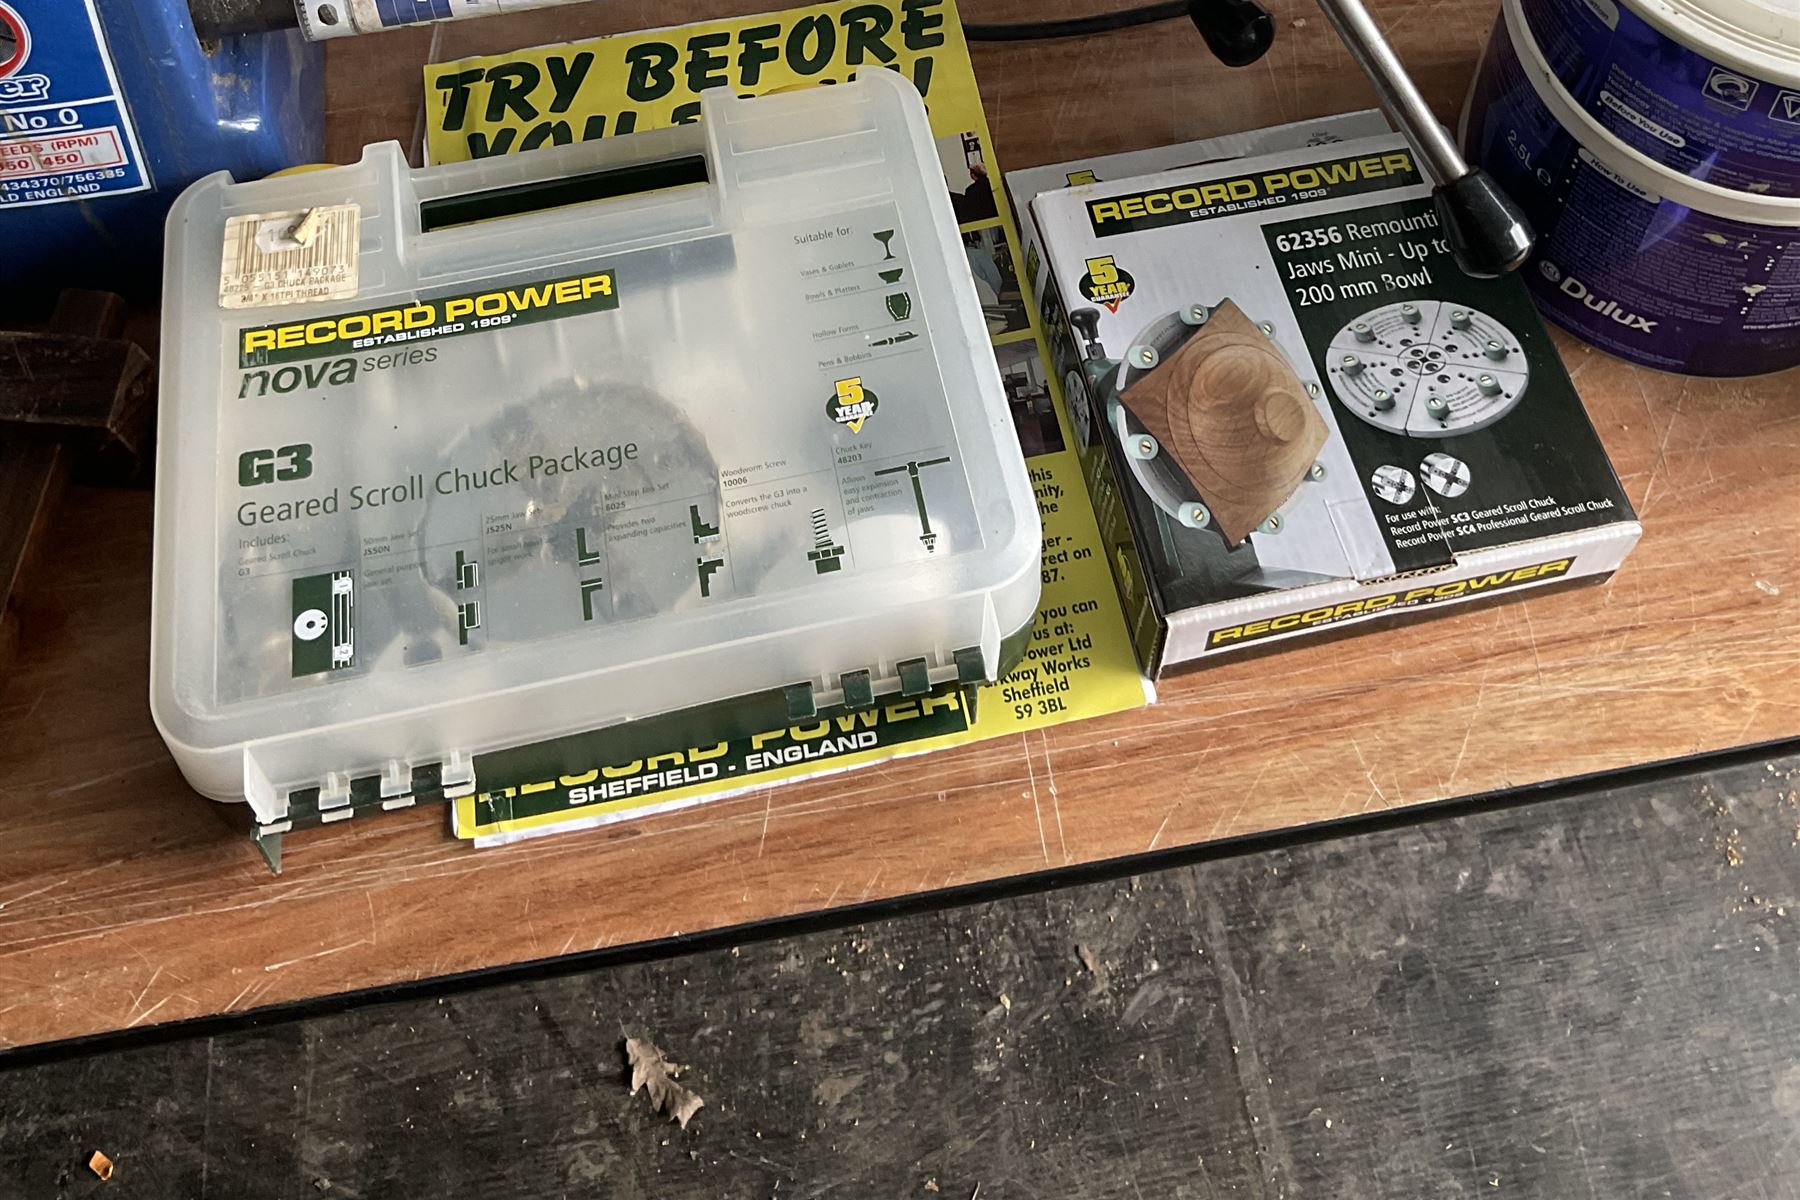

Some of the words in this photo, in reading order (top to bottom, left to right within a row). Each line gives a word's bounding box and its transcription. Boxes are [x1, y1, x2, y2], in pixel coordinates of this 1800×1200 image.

[434, 51, 594, 132] TRY
[4, 113, 48, 131] No
[1605, 95, 1637, 121] Before
[1639, 117, 1658, 134] You
[1659, 130, 1681, 145] Use
[0, 143, 44, 157] EEDS
[51, 136, 99, 151] (RPM)
[1507, 129, 1533, 171] 2.5L
[42, 153, 79, 166] 450
[1590, 158, 1611, 176] How
[1613, 173, 1625, 185] To
[1626, 181, 1647, 197] Use
[25, 182, 101, 200] ENGLAND
[1092, 179, 1258, 224] RECORD
[1263, 153, 1413, 196] POWER
[1190, 194, 1286, 219] ESTABLISHED
[793, 229, 834, 245] Suitable
[1275, 225, 1343, 253] 62356
[1345, 209, 1440, 242] Remounti
[1287, 257, 1335, 280] Jaws
[1337, 247, 1384, 271] Mini
[1399, 241, 1429, 263] Up
[1431, 236, 1450, 256] to
[800, 268, 820, 277] Vases
[829, 261, 855, 271] Goblets
[1085, 255, 1119, 285] 5
[277, 278, 306, 289] CHUCK
[308, 274, 347, 286] PACKAGE
[1295, 282, 1336, 307] 200
[1340, 279, 1378, 299] mm
[1381, 266, 1433, 293] Bowl
[296, 286, 330, 297] THREAD
[804, 291, 826, 300] Bowls
[835, 284, 861, 295] Platters
[243, 303, 436, 353] RECORD
[445, 273, 612, 323] POWER
[1559, 276, 1659, 334] Dulux
[352, 322, 466, 349] ESTABLISHED
[812, 329, 837, 339] Hollow
[838, 324, 860, 334] Forms
[818, 359, 835, 368] Pens
[844, 351, 872, 363] Bobbins
[237, 357, 358, 399] nova
[362, 344, 439, 372] series
[834, 376, 865, 406] 5
[835, 444, 857, 454] Chuck
[237, 443, 313, 487] G3
[837, 453, 863, 465] 48203
[721, 464, 763, 478] Woodworm
[764, 460, 787, 470] Screw
[236, 487, 339, 527] Geared
[350, 473, 424, 511] Scroll
[434, 459, 520, 496] Chuck
[528, 441, 639, 481] Package
[722, 476, 748, 488] 10006
[842, 474, 866, 485] Allows
[843, 486, 860, 496] easy
[861, 479, 899, 493] expansion
[623, 488, 640, 498] Step
[657, 482, 670, 490] Set
[725, 495, 758, 508] Converts
[759, 492, 772, 501] the
[773, 489, 784, 499] G3
[786, 487, 801, 496] into
[845, 496, 861, 506] and
[861, 489, 903, 502] contraction
[605, 501, 626, 512] 6025
[727, 504, 769, 518] woodscrew
[770, 499, 793, 510] chuck
[847, 507, 856, 516] of
[857, 506, 875, 516] jaws
[1385, 513, 1400, 524] For
[1401, 510, 1417, 520] use
[1418, 505, 1443, 518] with:
[1390, 521, 1421, 536] Record
[1421, 517, 1450, 531] Power
[1450, 511, 1470, 524] SC3
[1471, 505, 1503, 520] Geared
[1504, 500, 1527, 514] Scroll
[1528, 495, 1557, 509] Chuck
[486, 515, 510, 524] 25mm
[486, 523, 513, 535] JS25N
[607, 520, 640, 531] Provides
[1395, 535, 1427, 549] Record
[1427, 530, 1455, 543] Power
[1456, 524, 1476, 537] SC4
[1476, 513, 1530, 532] Professional
[1529, 507, 1562, 522] Geared
[1562, 502, 1588, 517] Scroll
[1587, 497, 1615, 511] Chuck
[239, 532, 290, 550] Includes:
[608, 528, 648, 542] expanding
[649, 521, 687, 535] capacities
[238, 555, 267, 566] Geared
[269, 549, 292, 562] Scroll
[293, 546, 317, 557] Chuck
[363, 545, 391, 557] JS50N
[1073, 547, 1092, 560] on
[238, 567, 251, 577] G3
[1212, 595, 1397, 644] RECORD
[1394, 559, 1571, 600] POWER
[1040, 606, 1067, 624] you
[1071, 600, 1098, 614] can
[1033, 627, 1050, 641] us
[1054, 622, 1075, 637] at:
[1023, 643, 1064, 661] ower
[1068, 633, 1092, 652] Ltd
[1041, 655, 1091, 676] Works
[1003, 676, 1070, 704] Sheffield
[1014, 703, 1033, 720] S9
[1038, 697, 1068, 715] 3BL
[568, 762, 719, 806] SHEFFIELD
[745, 730, 878, 771] ENGLAND
